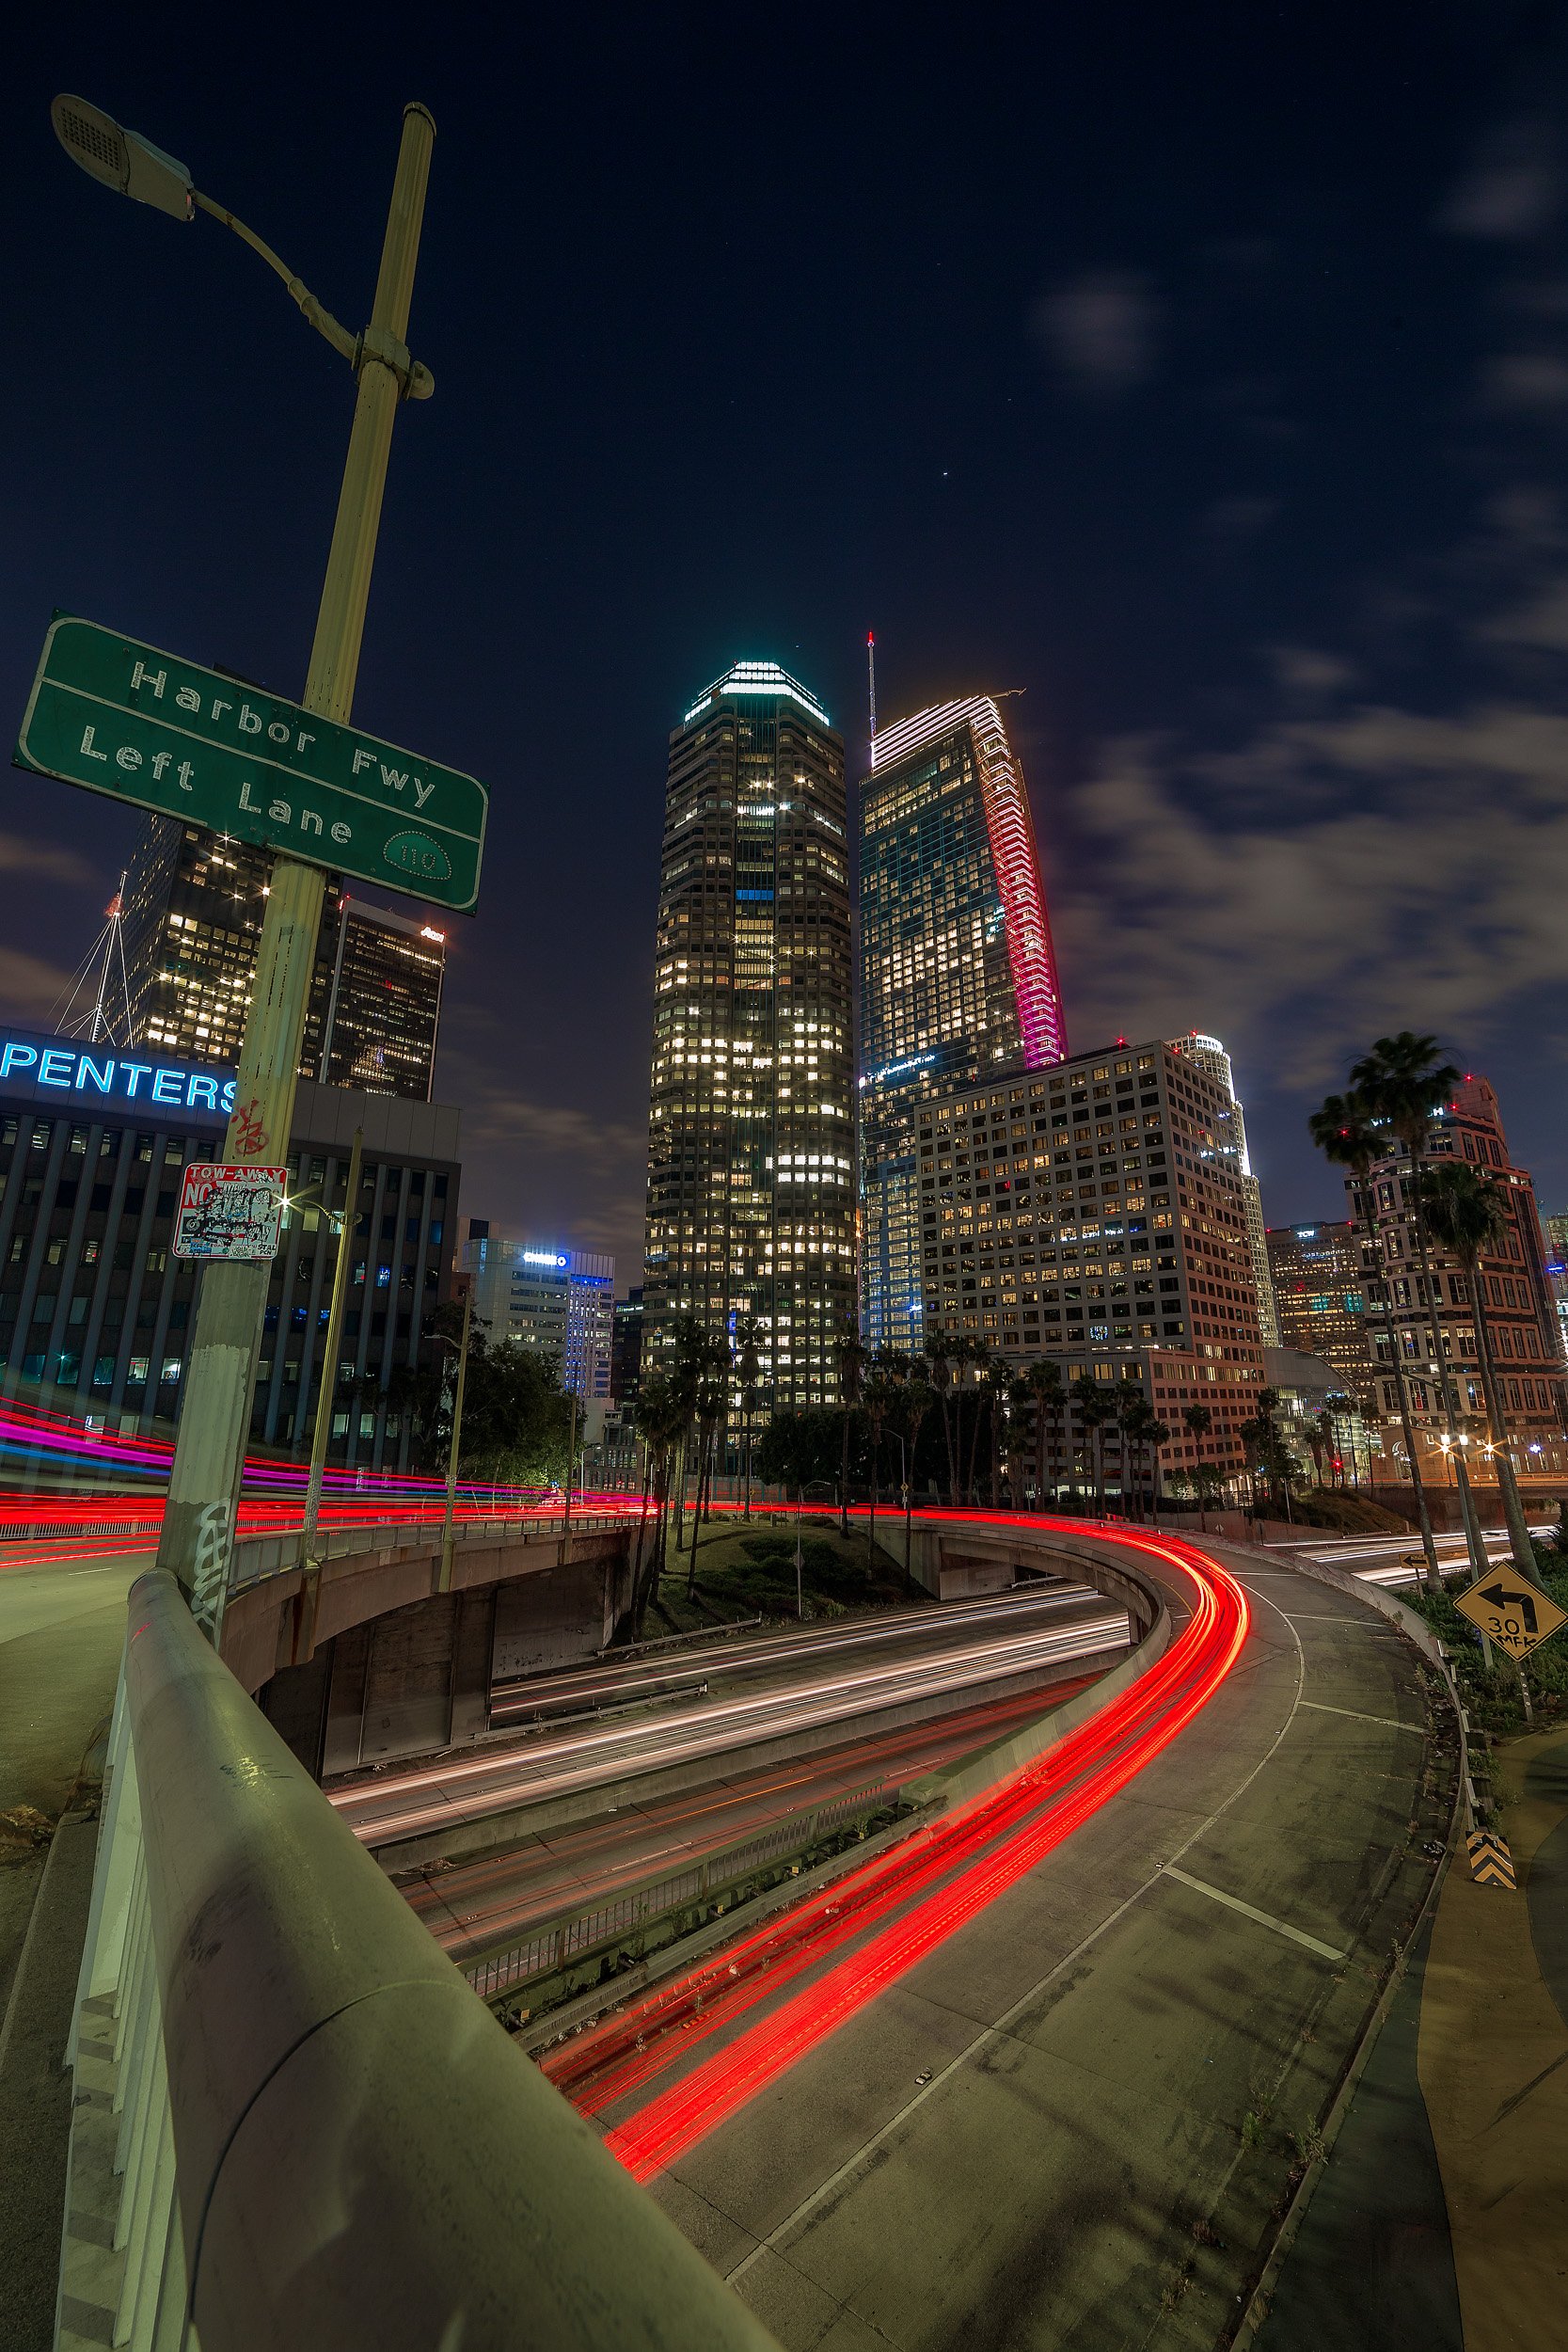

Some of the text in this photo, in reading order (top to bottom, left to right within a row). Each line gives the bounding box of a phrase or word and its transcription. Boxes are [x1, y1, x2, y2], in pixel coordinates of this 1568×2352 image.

[131, 661, 436, 808] Harbor Fwy
[80, 725, 352, 844] Left Lane
[402, 844, 436, 869] 110
[1297, 1230, 1315, 1238] TCW
[1488, 1616, 1520, 1635] 30
